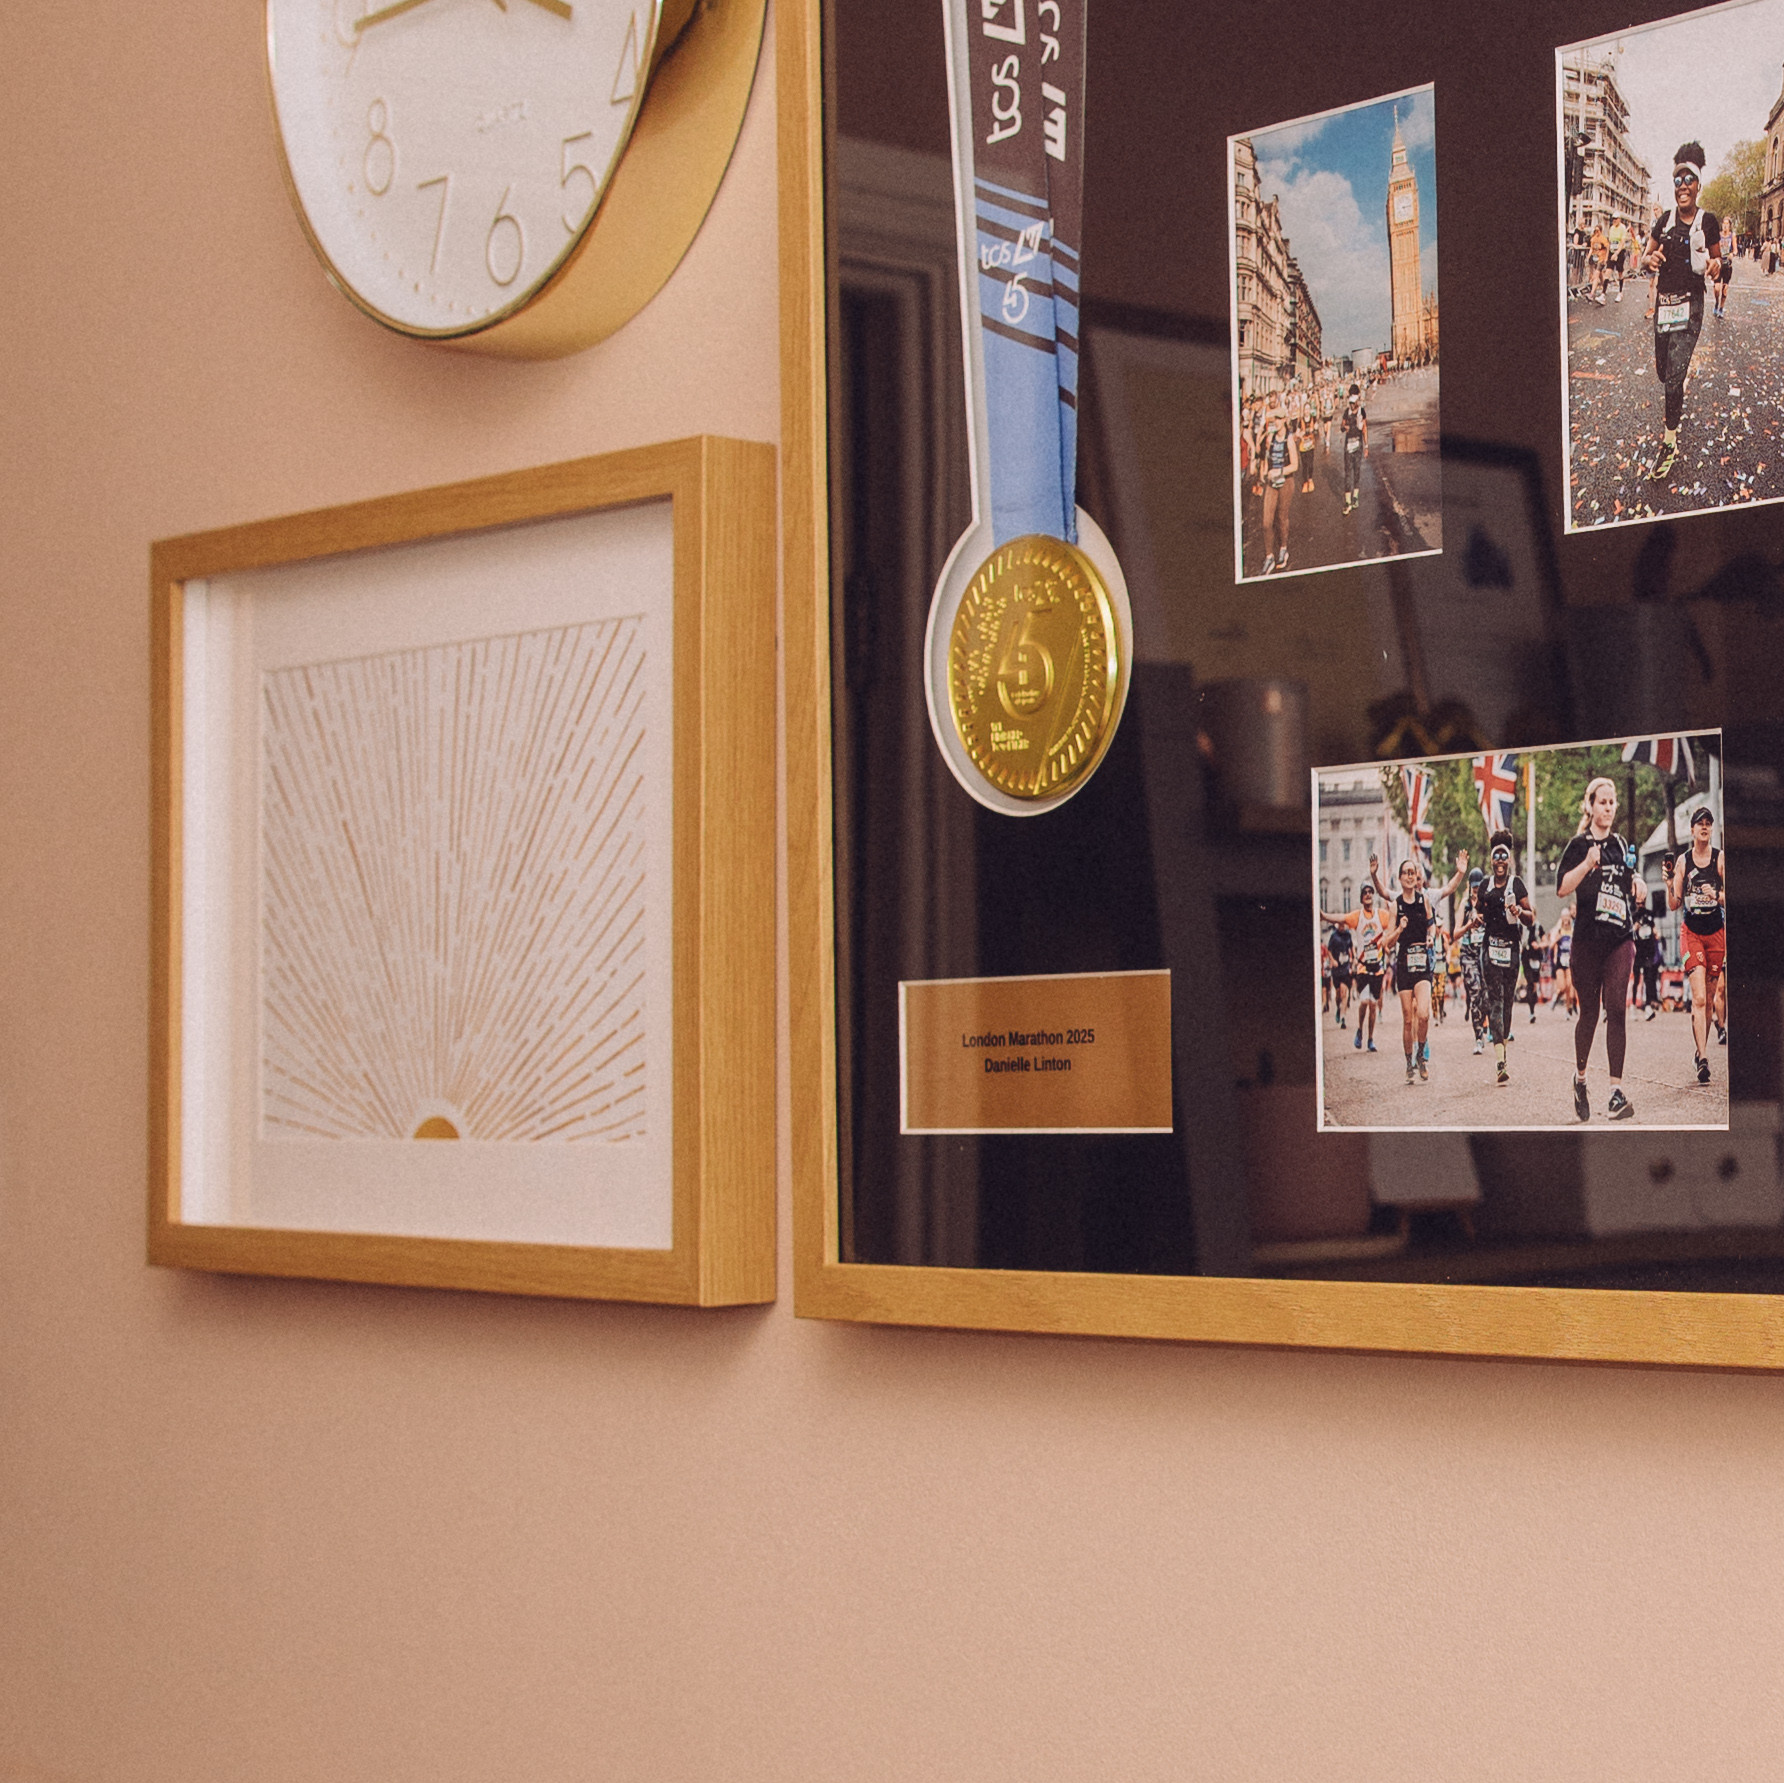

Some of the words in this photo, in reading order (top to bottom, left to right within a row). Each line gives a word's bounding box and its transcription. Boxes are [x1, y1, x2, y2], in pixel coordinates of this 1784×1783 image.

[363, 96, 398, 196] 8
[417, 174, 452, 275] 7
[485, 183, 524, 287] 6
[962, 1031, 1006, 1047] London
[1008, 1029, 1064, 1046] Marathon
[1066, 1028, 1095, 1045] 2025
[984, 1056, 1031, 1073] Danielle
[1033, 1056, 1072, 1072] Linton
